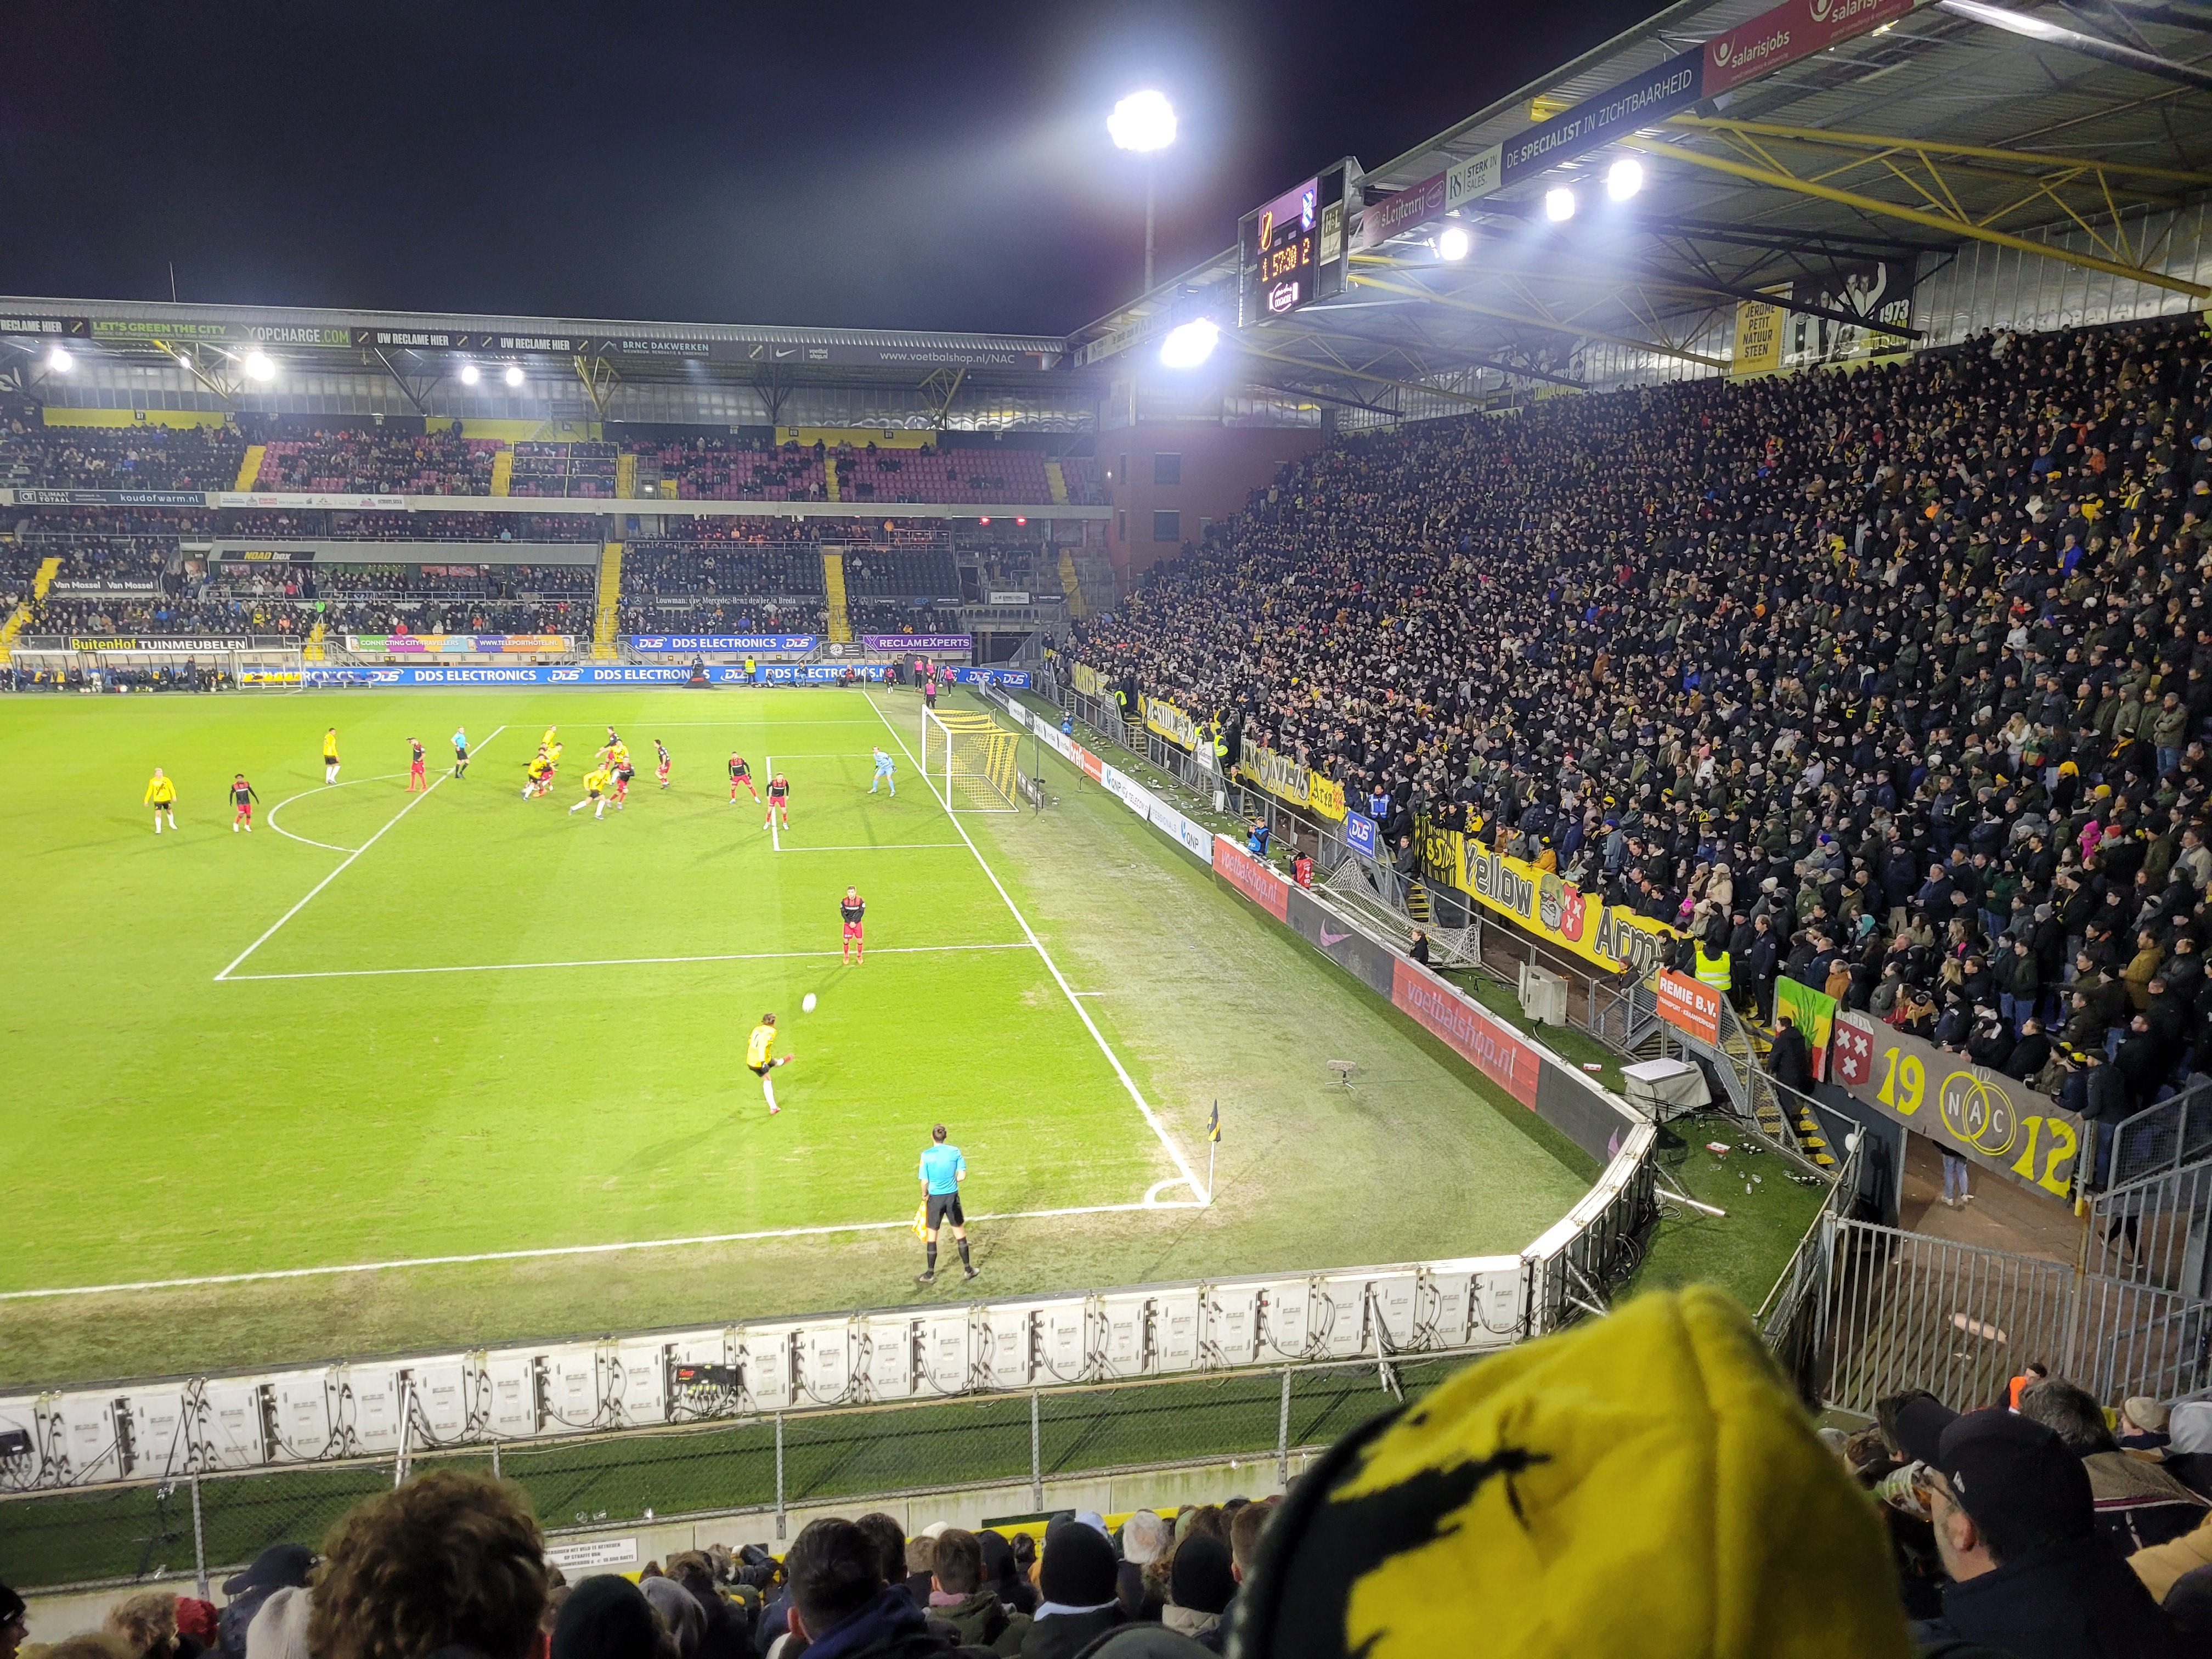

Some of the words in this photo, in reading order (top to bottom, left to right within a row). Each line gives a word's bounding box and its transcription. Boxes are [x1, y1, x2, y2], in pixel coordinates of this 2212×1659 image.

[1731, 30, 1790, 69] salarisjobs
[1507, 150, 1519, 169] DE
[1521, 120, 1581, 162] SPECIALIST
[1583, 115, 1596, 134] IN
[1598, 69, 1692, 127] ZICHTBAARHEID
[1468, 157, 1488, 178] STERK
[1489, 154, 1497, 168] IN
[1262, 257, 1268, 282] 1
[1302, 238, 1310, 264] 2
[1880, 299, 1909, 323] 1973
[1, 319, 41, 332] RECLAME
[42, 320, 63, 333] HIER
[93, 321, 127, 331] LET'S
[128, 323, 170, 332] GREEN
[173, 324, 196, 334] THE
[198, 325, 226, 334] CITY
[1748, 317, 1770, 331] PETIT
[377, 332, 391, 344] UW
[392, 334, 430, 346] RECLAME
[431, 335, 449, 346] HIER
[500, 337, 515, 349] UW
[515, 337, 551, 350] RECLAME
[552, 340, 570, 351] HIER
[1743, 329, 1773, 345] NATUUR
[623, 341, 648, 349] BRNC
[651, 342, 709, 351] DAKWERKEN
[1745, 343, 1768, 358] STEEN
[880, 351, 1015, 364] www.voetbalshop.nl/NAC
[120, 493, 200, 503] koudofwarm.nl
[244, 551, 272, 561] NOAD
[272, 552, 291, 561] box
[54, 581, 71, 589] Van
[72, 581, 101, 590] Mossel
[107, 581, 124, 589] Van
[125, 581, 154, 590] Mossel
[72, 638, 136, 651] BuitenHof
[138, 640, 246, 650] TUINMEUBELEN
[639, 639, 664, 648] DDS
[673, 638, 697, 648] DDS
[702, 638, 776, 648] ELECTRONICS
[785, 638, 810, 647] DDS
[879, 637, 969, 648] RECLAMEXPERTS
[415, 670, 443, 681] DDS
[447, 670, 537, 681] ELECTRONICS
[551, 669, 579, 681] DDS
[594, 669, 622, 680] DDS
[625, 669, 710, 680] ELECTRONIS
[969, 671, 990, 682] DDS
[1003, 673, 1025, 685] DDS
[1111, 778, 1121, 792] QNP
[1128, 792, 1144, 812] TELECOM
[1351, 819, 1370, 842] DDS
[1186, 832, 1199, 850] QNP
[1221, 849, 1278, 903] voetbalshop.nl
[1462, 839, 1534, 919] Yellow
[1660, 976, 1694, 1006] REMIE
[1695, 995, 1717, 1018] B.V.
[1659, 996, 1681, 1013] TRANSPORT
[1840, 1011, 1872, 1031] BREDA
[1407, 980, 1517, 1078] voetbalshop.nl
[1876, 1047, 1925, 1116] 19
[2010, 1115, 2077, 1199] 12
